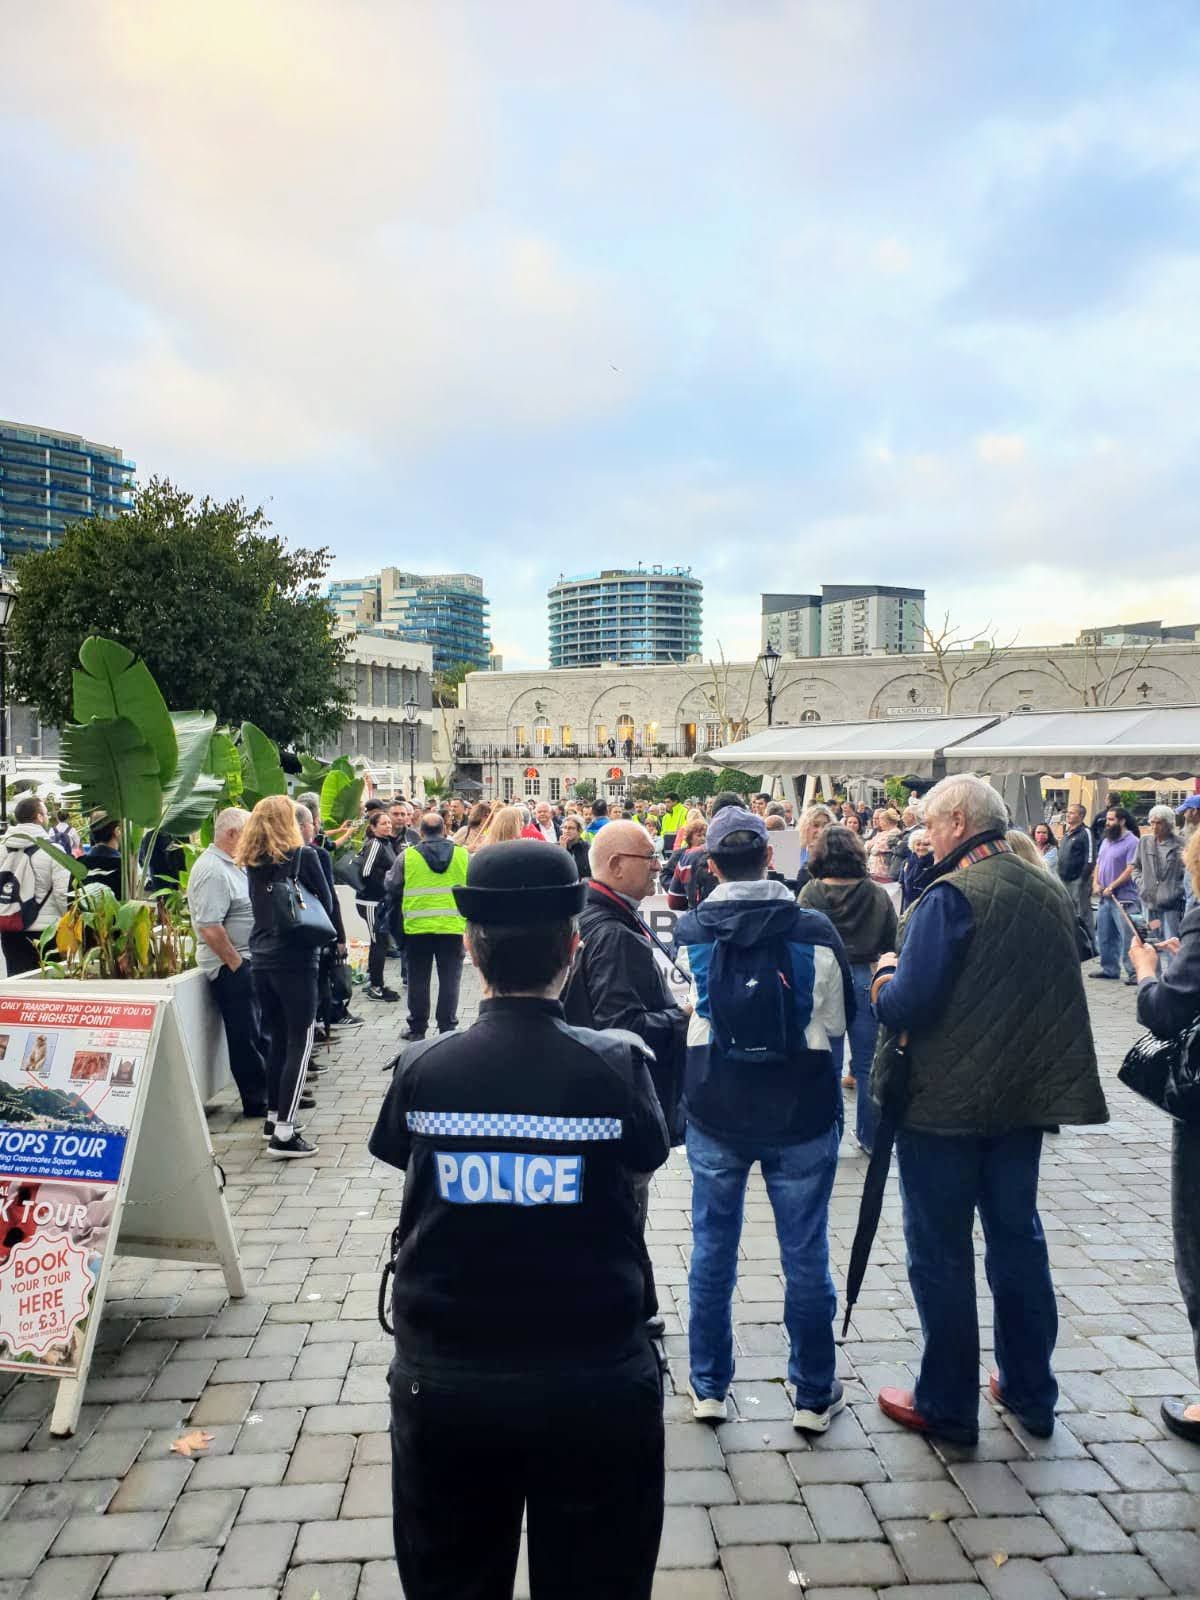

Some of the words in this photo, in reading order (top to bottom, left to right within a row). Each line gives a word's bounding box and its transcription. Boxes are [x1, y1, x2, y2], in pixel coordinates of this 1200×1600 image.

[0, 1001, 21, 1010] ONLY
[22, 1002, 65, 1012] TRANSPORT
[65, 1004, 83, 1013] THAT
[84, 1005, 103, 1014] CAN
[103, 1006, 121, 1015] TAKE
[122, 1007, 139, 1016] YOU
[141, 1008, 152, 1016] TO
[19, 1011, 38, 1022] THE
[38, 1012, 79, 1024] HIGHEST
[79, 1015, 112, 1025] POINT!
[52, 1135, 107, 1158] TOUR
[12, 1154, 51, 1164] Casemates
[52, 1157, 78, 1166] Square
[29, 1165, 38, 1173] to
[38, 1166, 50, 1174] the
[51, 1167, 63, 1175] top
[64, 1167, 73, 1176] of
[73, 1168, 85, 1176] the
[85, 1169, 104, 1178] Rock
[437, 1154, 578, 1204] POLICE
[21, 1200, 88, 1228] TOUR
[15, 1249, 69, 1278] BOOK
[10, 1278, 40, 1294] YOUR
[42, 1271, 72, 1287] TOUR
[19, 1288, 64, 1316] HERE
[19, 1320, 34, 1332] for
[38, 1309, 66, 1330] £31
